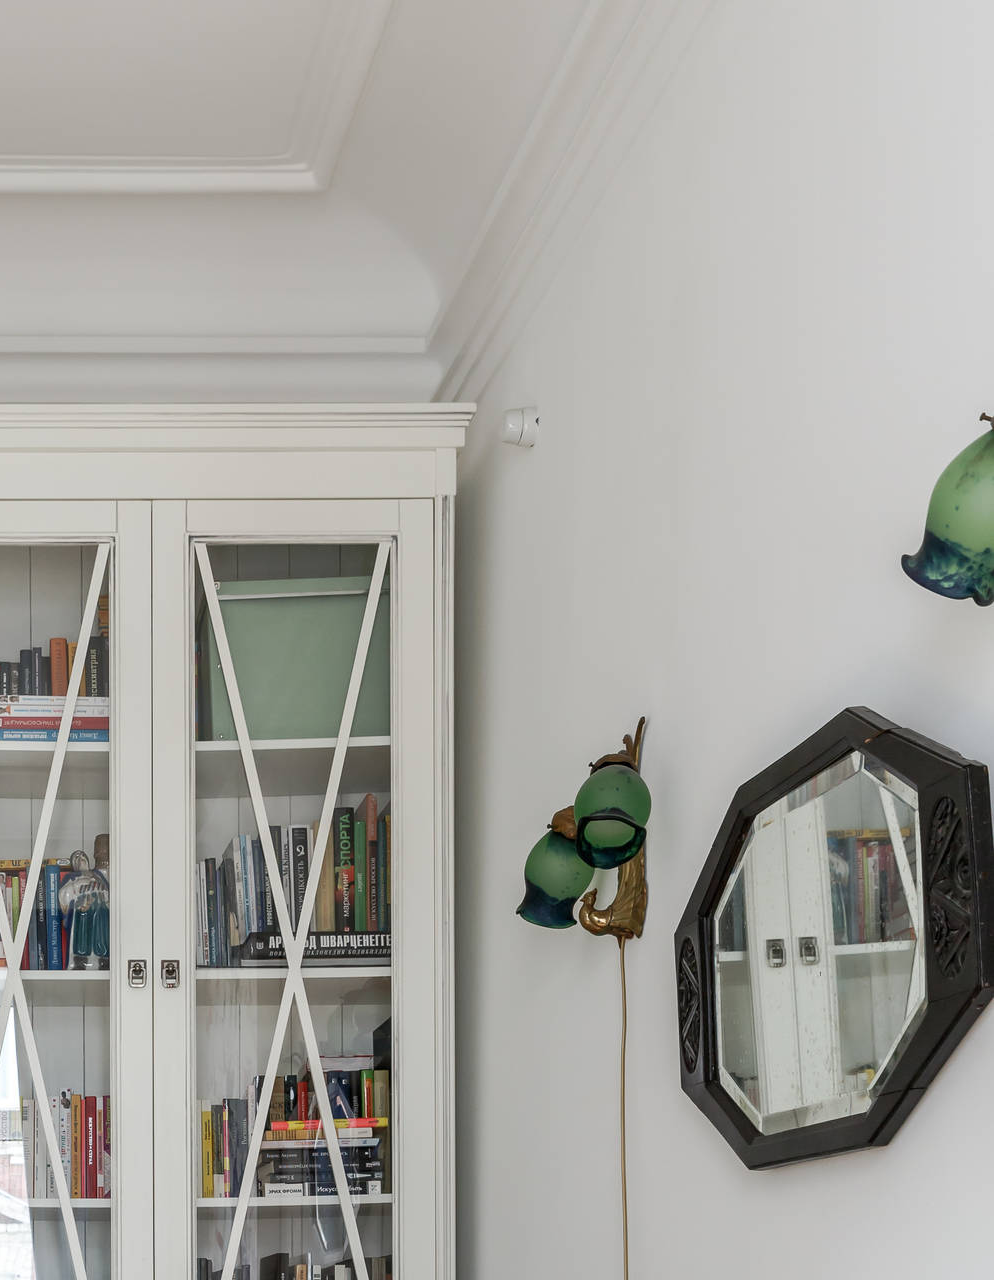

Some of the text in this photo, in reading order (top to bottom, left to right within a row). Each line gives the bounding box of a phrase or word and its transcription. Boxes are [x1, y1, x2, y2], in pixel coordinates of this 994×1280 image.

[340, 813, 351, 870] СПОРТА
[269, 935, 391, 949] АРЬД ШВАРЦЕНЕГГЕ
